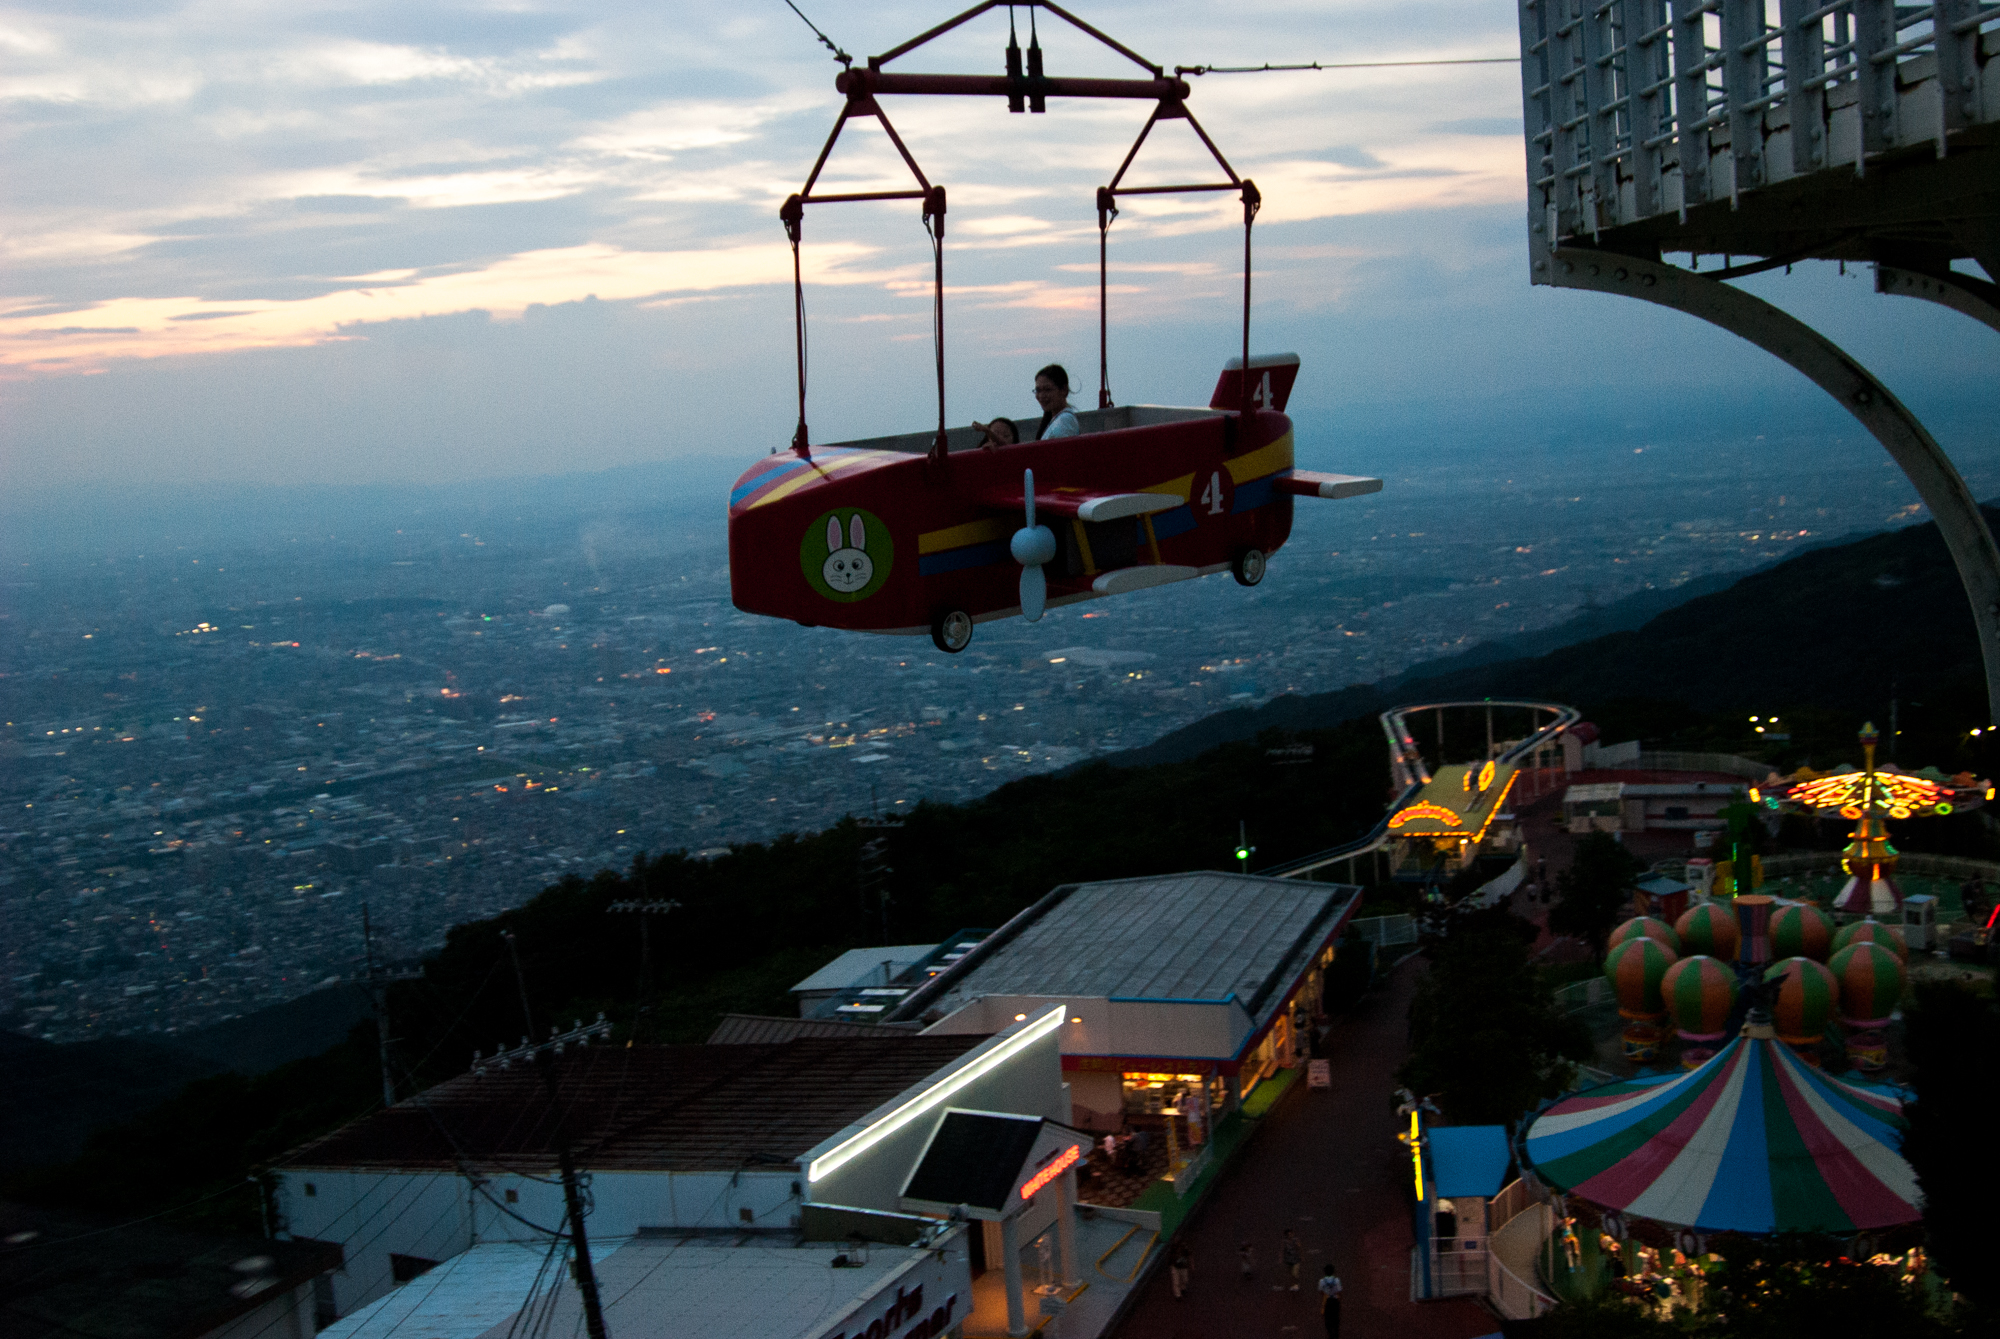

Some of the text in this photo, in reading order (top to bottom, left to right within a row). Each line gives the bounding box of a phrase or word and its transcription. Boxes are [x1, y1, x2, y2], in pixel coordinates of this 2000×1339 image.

[1250, 371, 1274, 410] 4
[1200, 470, 1225, 516] 4
[832, 1283, 924, 1339] orts
